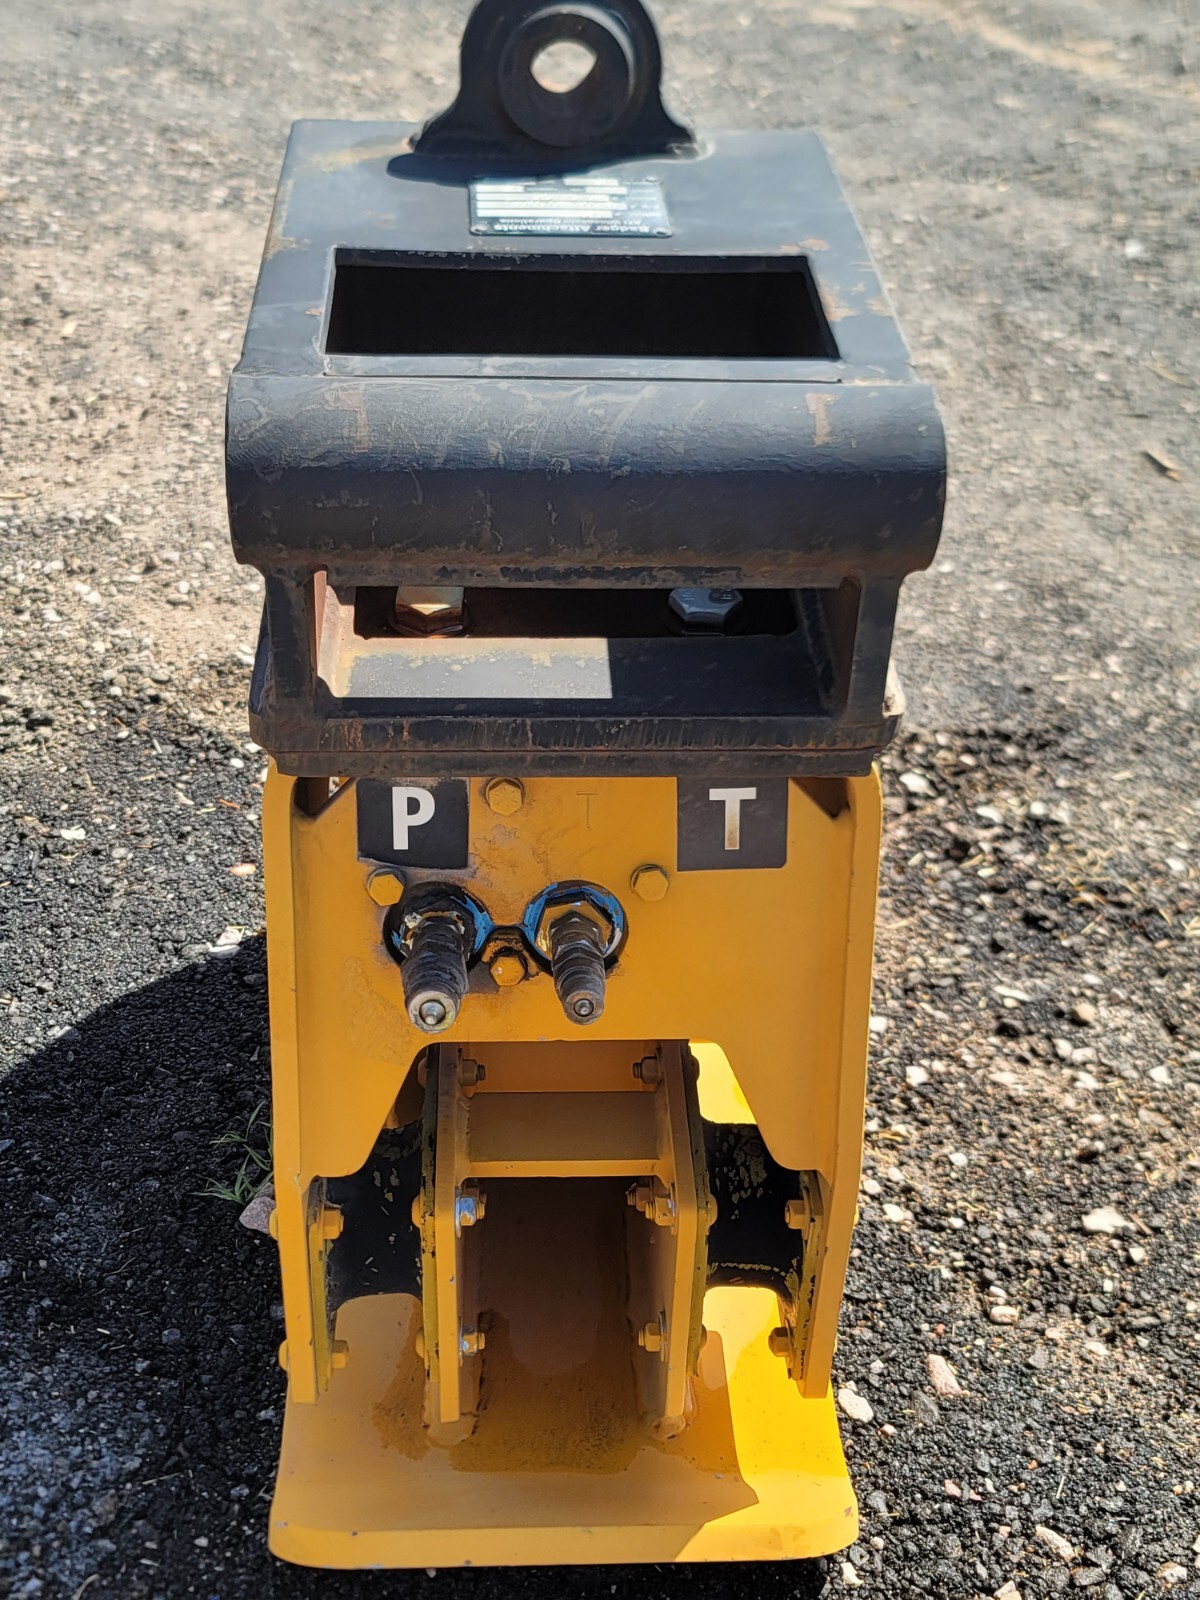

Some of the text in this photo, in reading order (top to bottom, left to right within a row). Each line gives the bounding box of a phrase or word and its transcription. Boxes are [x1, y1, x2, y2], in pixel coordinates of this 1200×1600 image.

[493, 224, 650, 233] Badger Attachments
[498, 217, 562, 226] Operations
[391, 786, 436, 851] P
[708, 786, 758, 851] T
